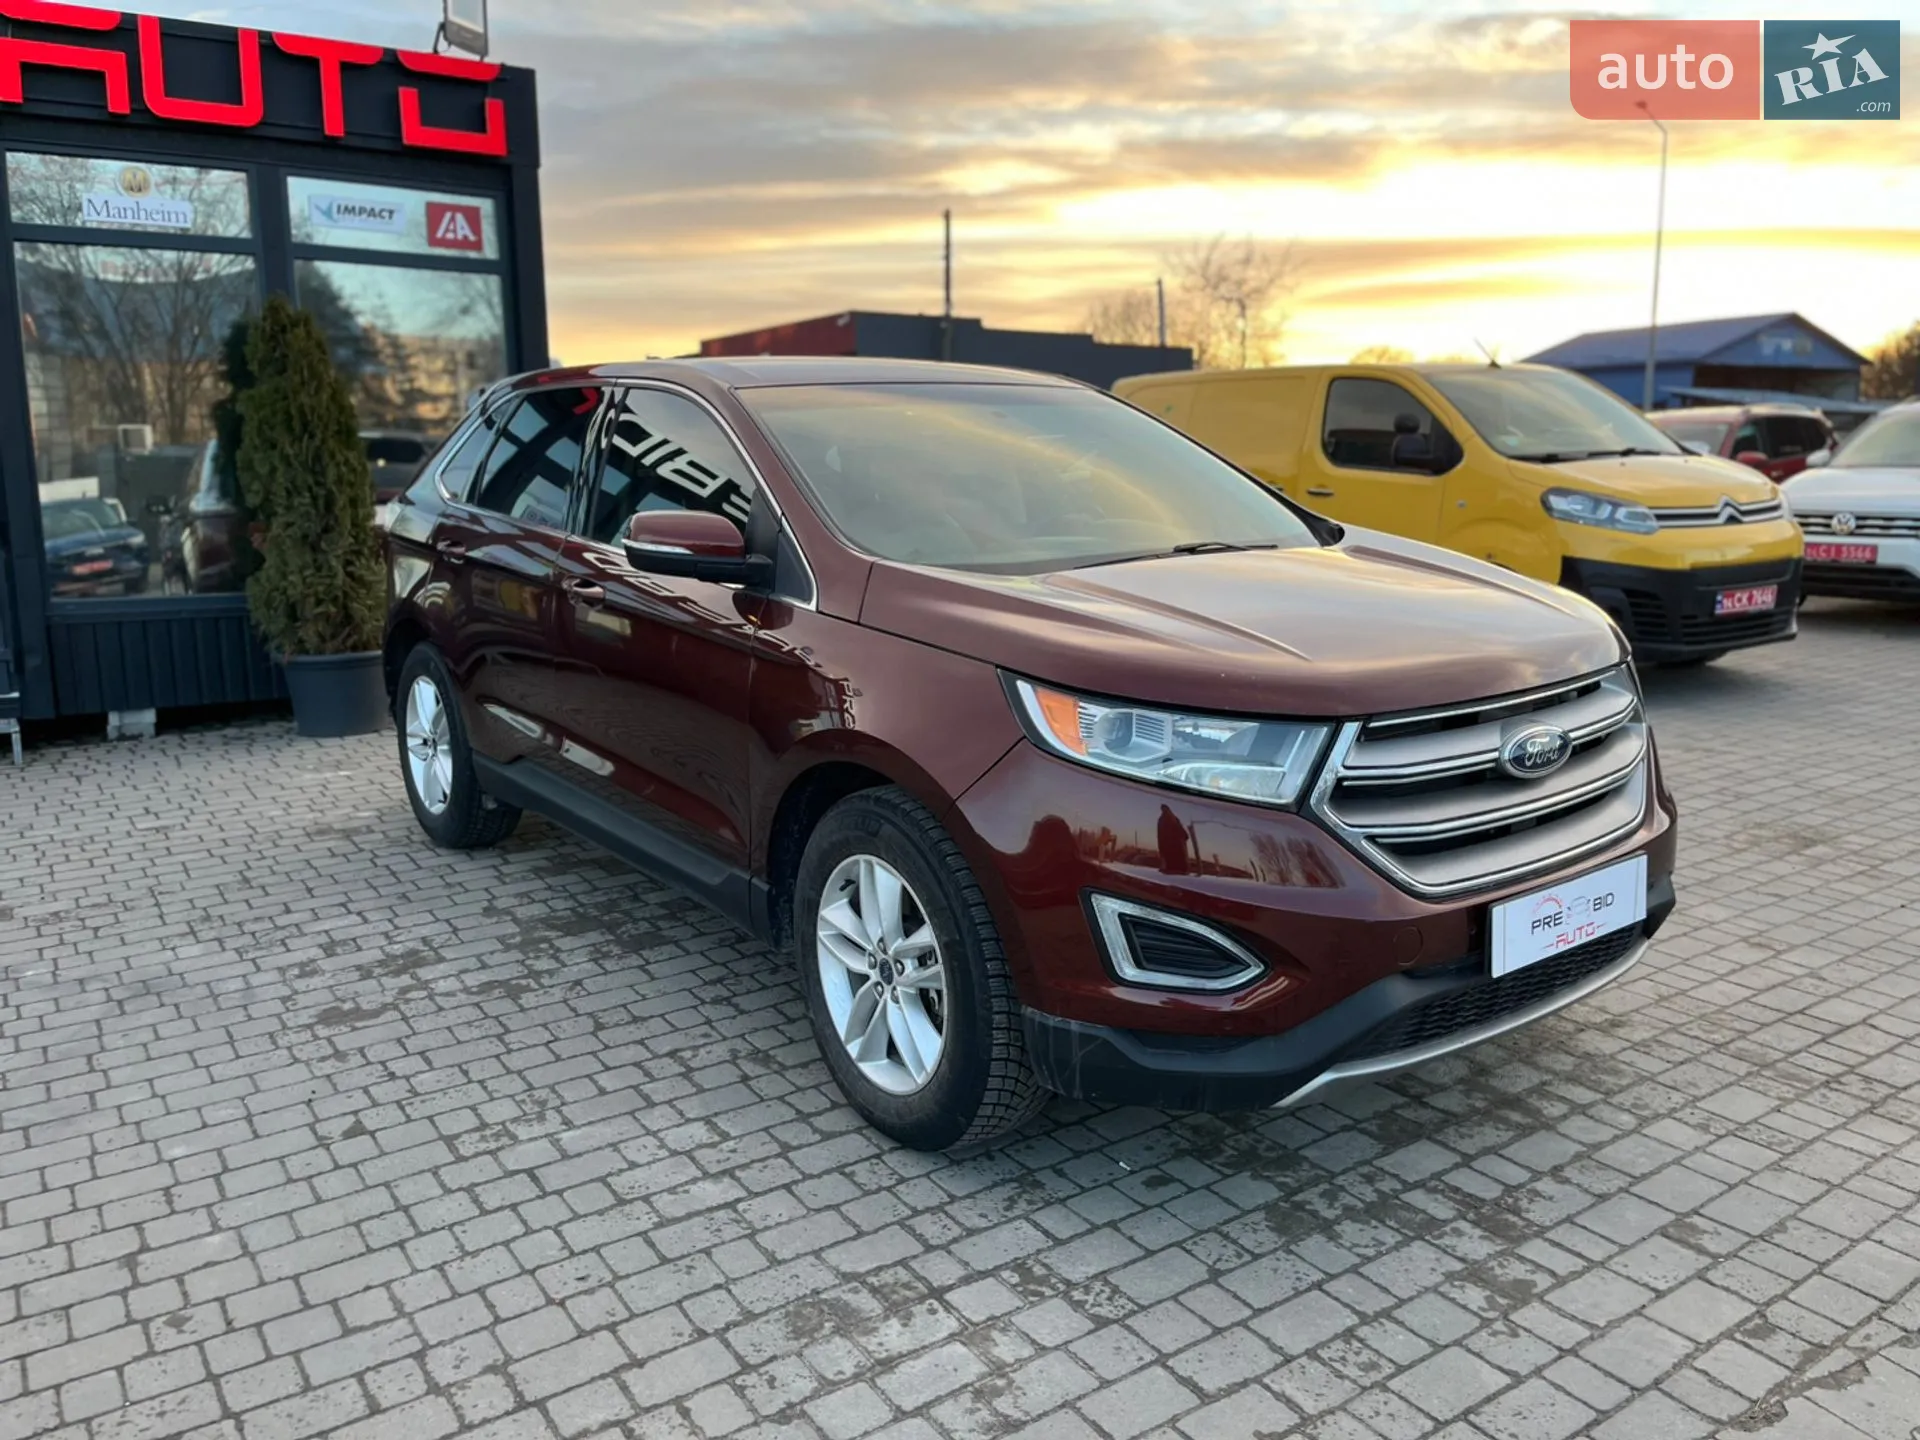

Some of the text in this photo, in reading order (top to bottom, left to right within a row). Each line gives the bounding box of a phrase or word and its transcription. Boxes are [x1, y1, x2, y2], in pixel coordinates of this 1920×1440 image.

[0, 0, 508, 157] AUTO
[86, 197, 189, 225] Manheim
[335, 202, 396, 222] IMPACT
[1524, 735, 1564, 767] Ford
[1530, 891, 1615, 936] PRE BID
[1554, 921, 1597, 950] AUTO
